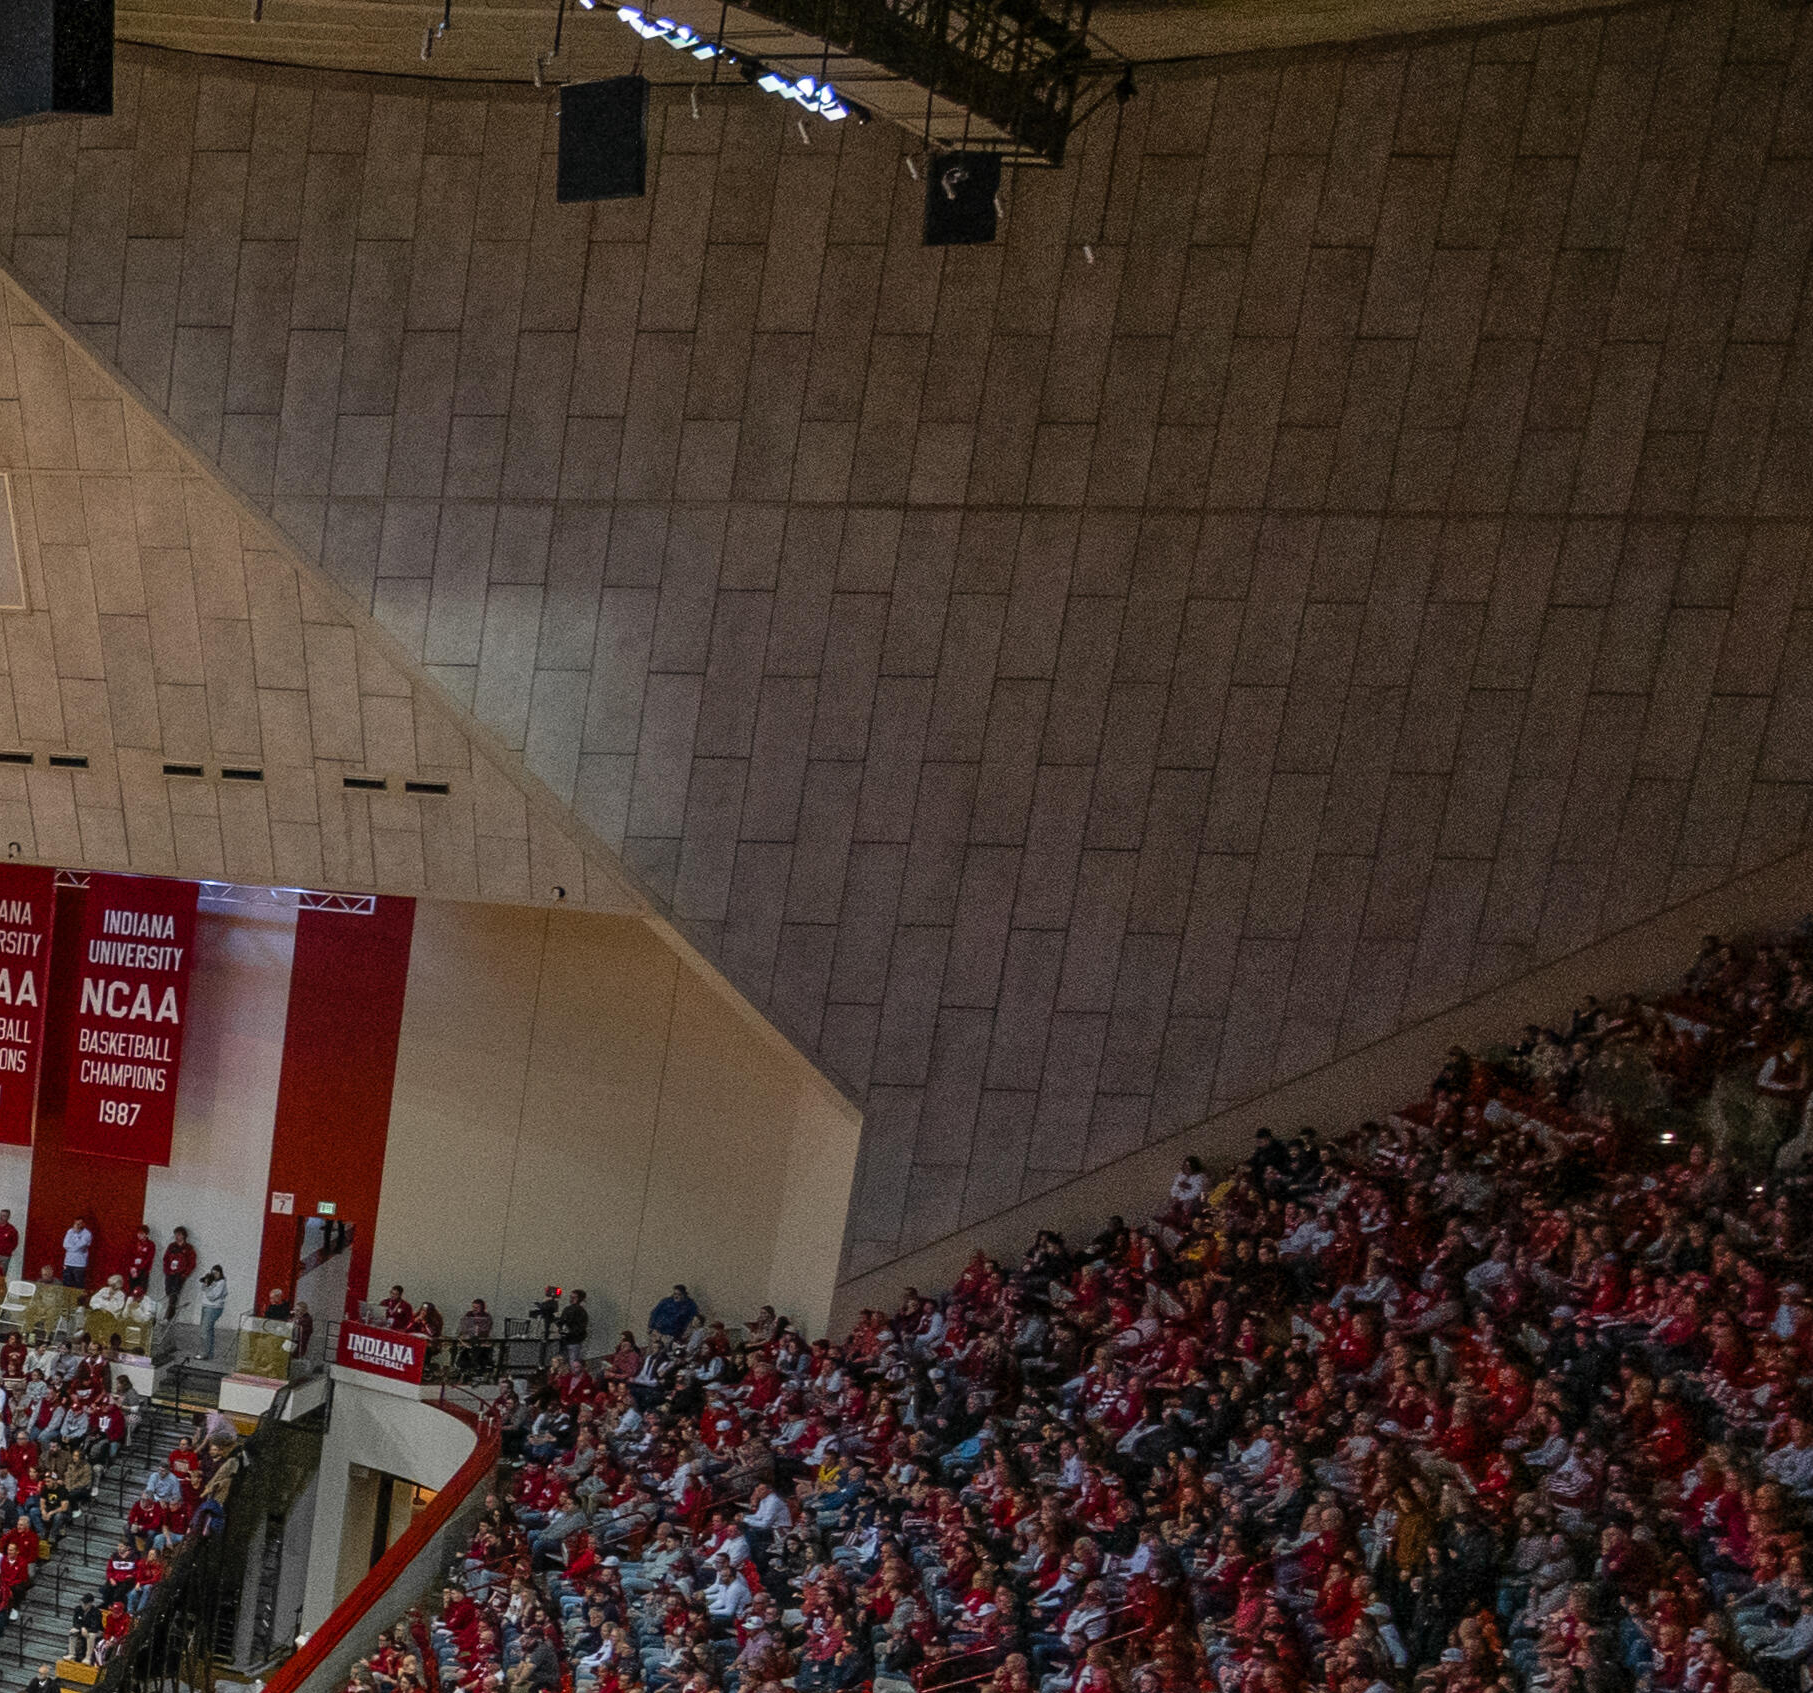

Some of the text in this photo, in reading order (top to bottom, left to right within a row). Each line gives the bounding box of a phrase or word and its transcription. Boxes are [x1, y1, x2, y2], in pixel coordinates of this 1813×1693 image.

[103, 910, 174, 940] INDIANA
[88, 939, 183, 972] UNIVERSITY
[80, 978, 179, 1024] NCAA
[79, 1029, 172, 1062] BASKETBALL
[81, 1060, 166, 1092] CHAMPIONS
[99, 1100, 141, 1126] 1987
[347, 1333, 413, 1365] INDIANA
[353, 1352, 405, 1371] BASKETBALL
